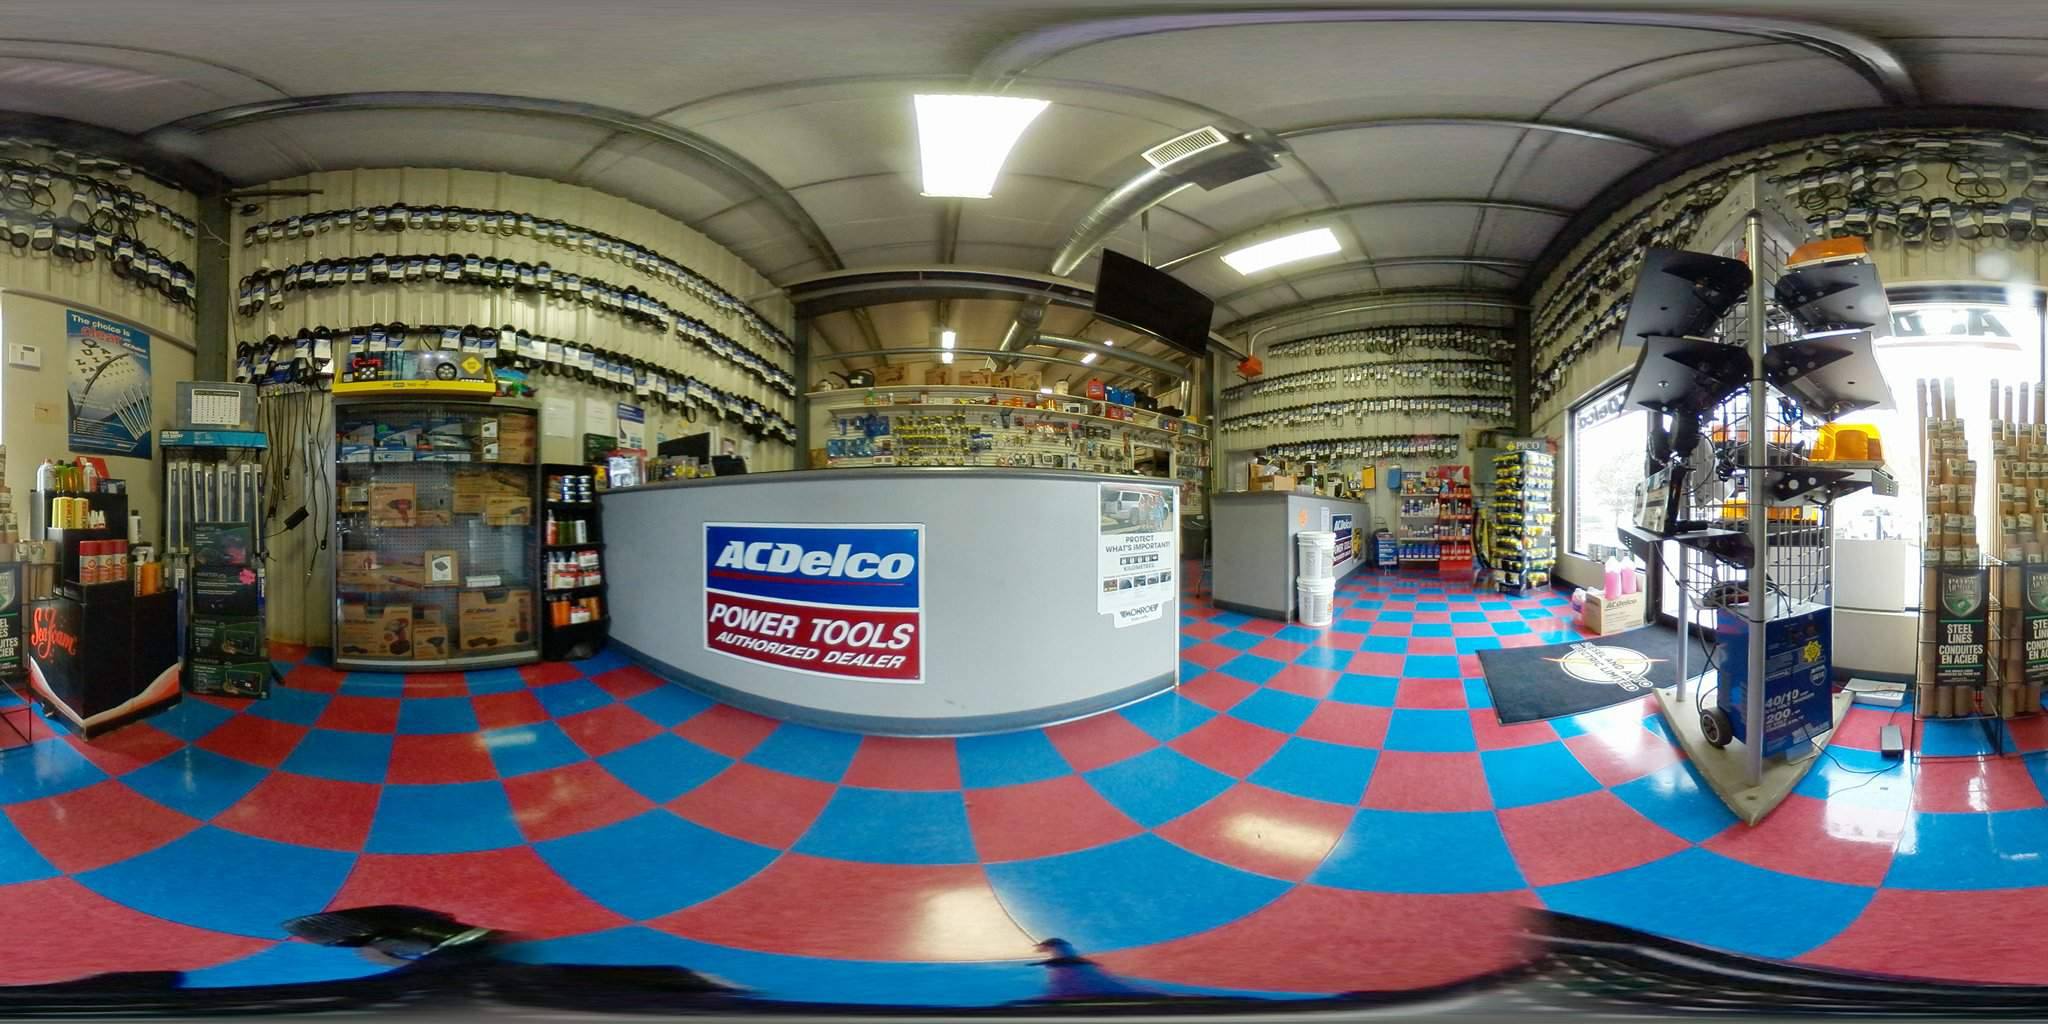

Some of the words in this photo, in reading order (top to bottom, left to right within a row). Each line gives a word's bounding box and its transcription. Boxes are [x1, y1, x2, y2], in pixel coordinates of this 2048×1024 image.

[71, 314, 90, 325] The
[92, 321, 121, 333] choice
[123, 328, 130, 337] is
[1516, 441, 1540, 450] PICO
[1126, 535, 1154, 543] PROTECT
[1106, 545, 1133, 553] WHAT'S
[715, 540, 915, 580] ACDelco
[1124, 604, 1156, 617] MONROE
[709, 602, 800, 639] POWER
[809, 618, 915, 649] TOOLS
[1946, 623, 1973, 634] STEEL
[1948, 633, 1973, 644] LINES
[715, 631, 820, 661] AUTHORIZED
[822, 650, 906, 669] DEALER
[1938, 644, 1983, 655] CONDUITES
[2029, 649, 2039, 660] EN
[1941, 654, 1952, 664] EN
[1954, 654, 1978, 664] ACIER
[1765, 708, 1792, 725] 200
